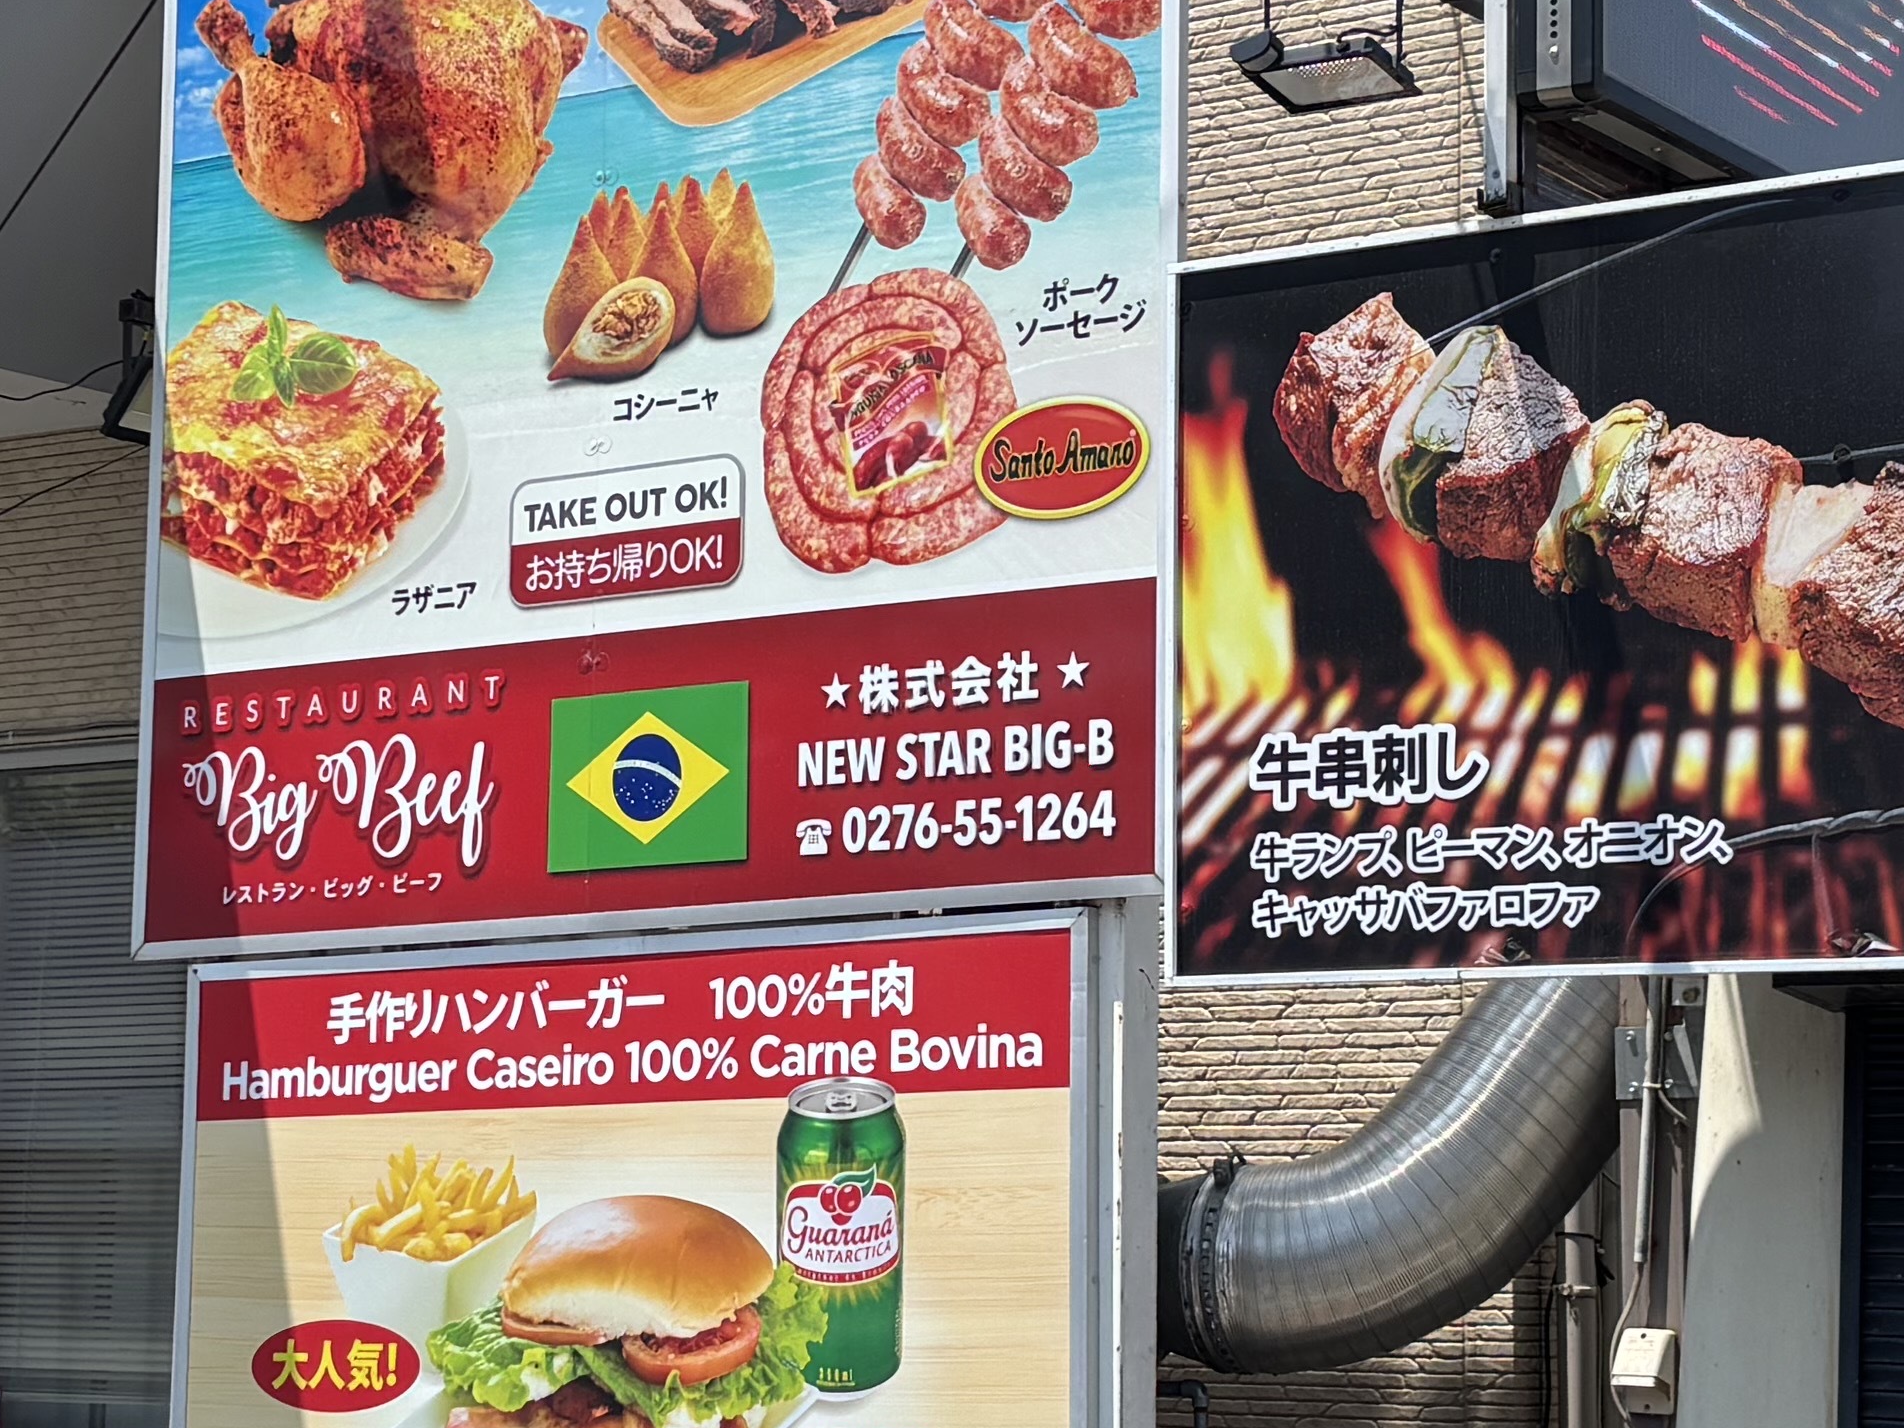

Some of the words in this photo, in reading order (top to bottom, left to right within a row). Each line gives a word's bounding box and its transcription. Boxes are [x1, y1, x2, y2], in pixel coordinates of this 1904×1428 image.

[1042, 273, 1120, 312] ポーク
[1015, 299, 1148, 347] ソーセージ
[613, 387, 720, 423] コシーニャ
[990, 437, 1056, 483] Santo
[523, 497, 598, 533] TAKE
[606, 487, 669, 525] OUT
[675, 476, 728, 516] OK!
[524, 534, 725, 593] お持ち帰りOK!
[390, 580, 478, 616] ラザニア
[183, 674, 500, 729] RESTAURANT
[858, 649, 1040, 716] 株式会社
[797, 735, 886, 788] NEW
[896, 727, 992, 781] STAR
[1003, 718, 1115, 772] BIG-B
[1255, 729, 1483, 804] 牛串刺し
[182, 745, 319, 861] Big
[315, 733, 495, 867] Beef
[842, 788, 1117, 854] 0276-55-1264
[1254, 886, 1597, 935] キャッサバファロファ
[325, 974, 666, 1047] 手作りハンバーガー
[708, 960, 915, 1020] 100%牛肉
[221, 1055, 458, 1107] Hamburguer
[465, 1043, 615, 1091] Caseiro
[624, 1034, 739, 1084] 100%
[748, 1032, 877, 1078] Carne
[894, 1020, 1044, 1072] Bovina
[787, 1205, 894, 1254] Guaraná
[804, 1239, 893, 1264] ANTARCTICA
[270, 1337, 399, 1394] 大人気!
